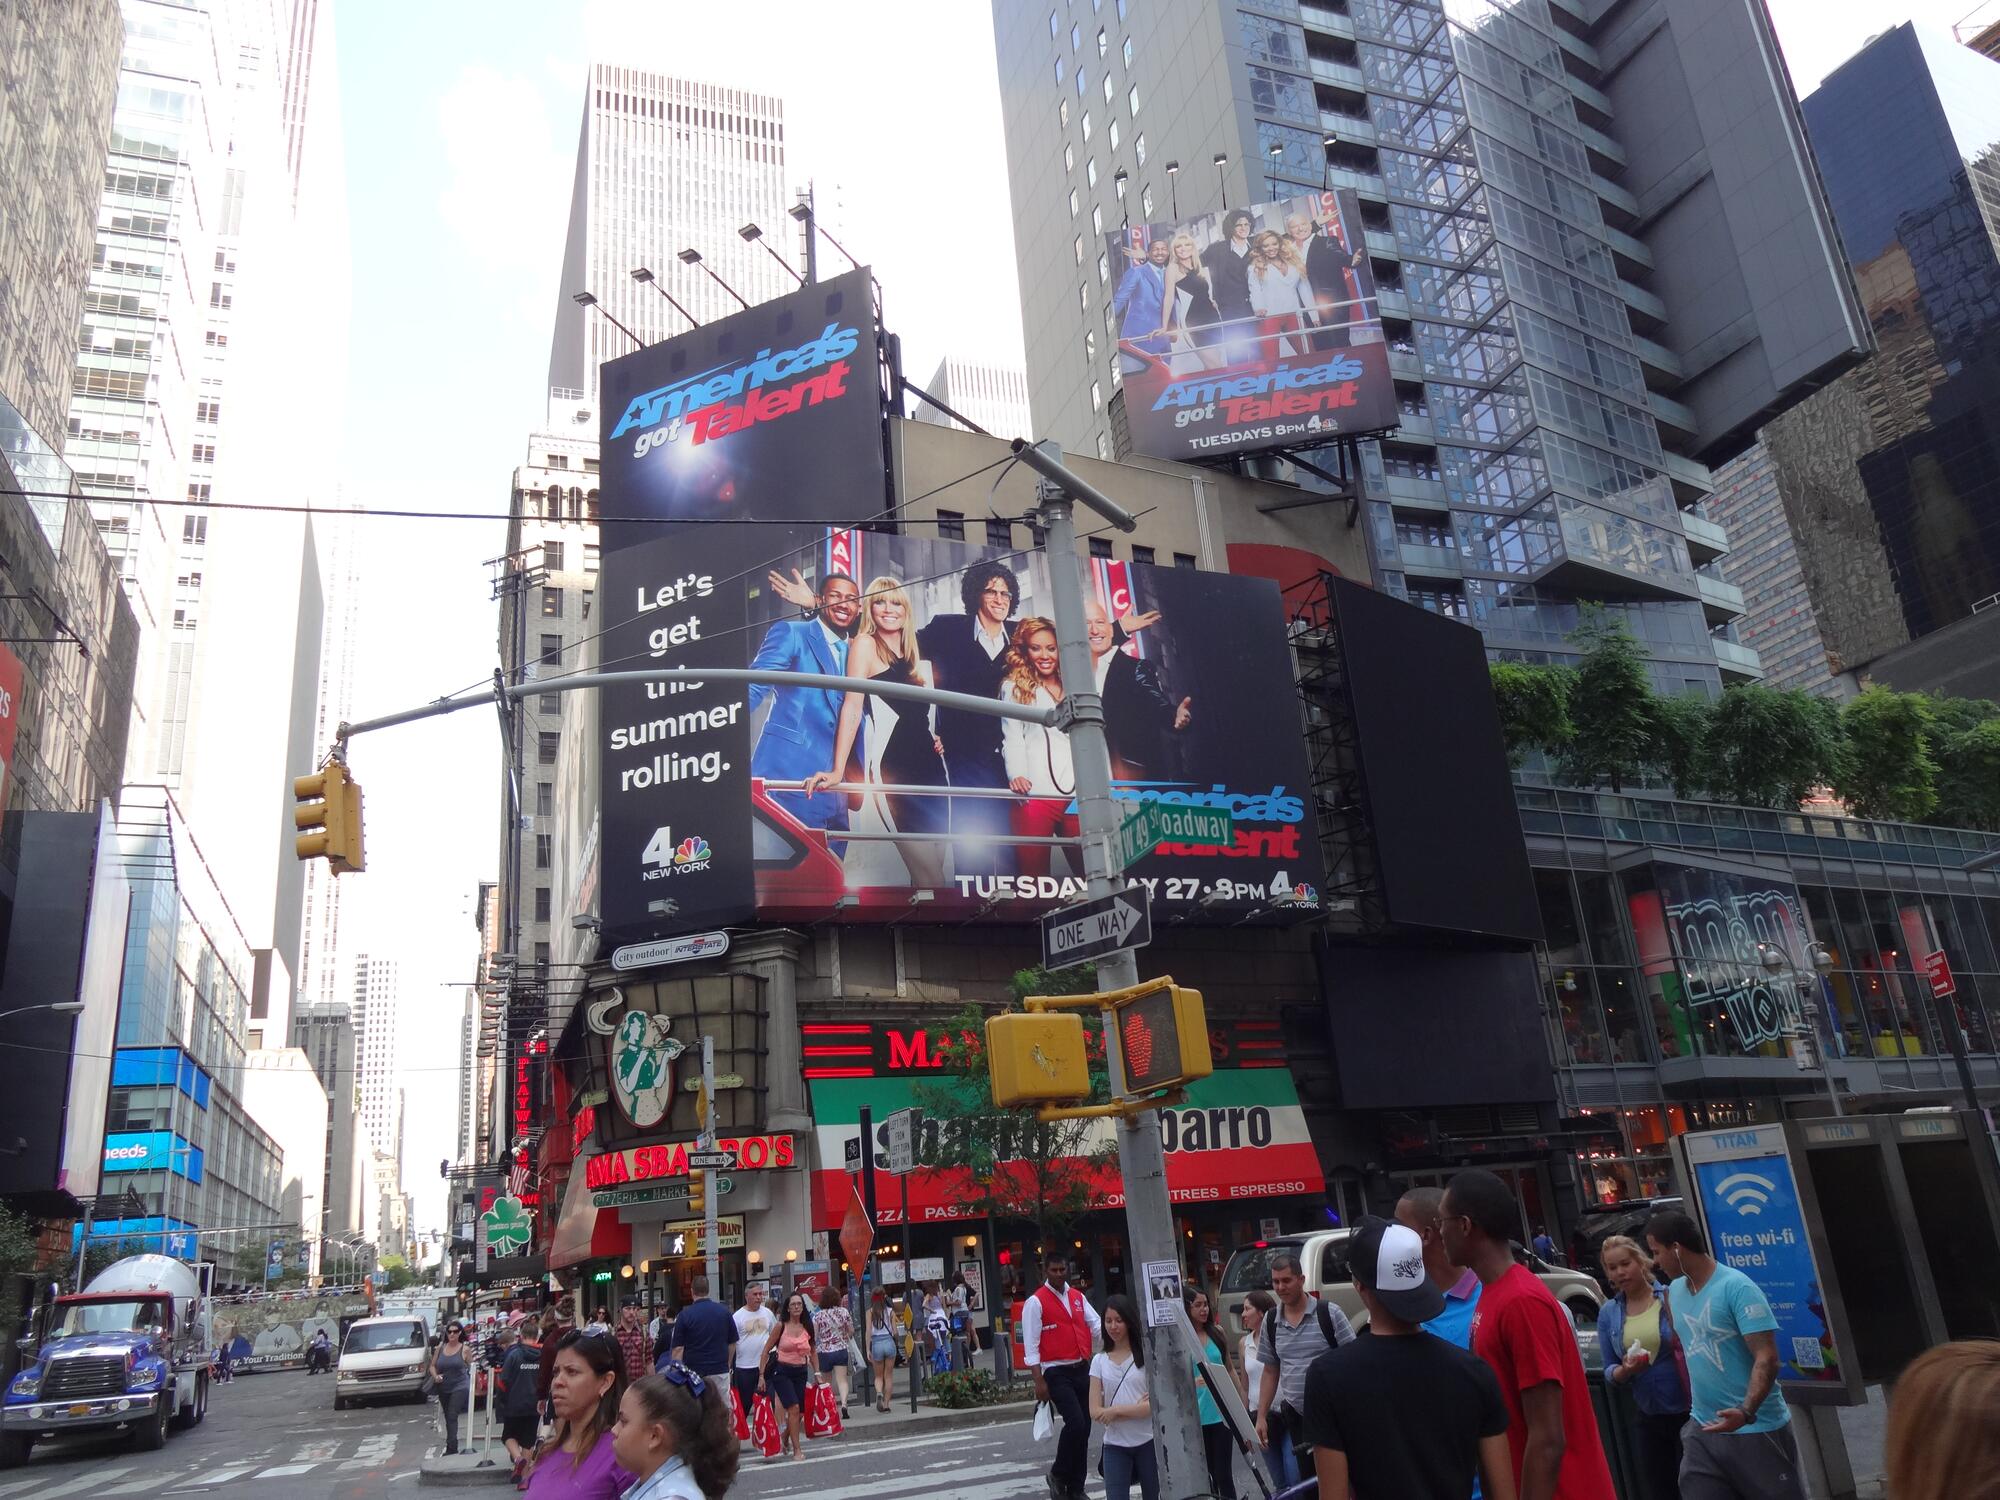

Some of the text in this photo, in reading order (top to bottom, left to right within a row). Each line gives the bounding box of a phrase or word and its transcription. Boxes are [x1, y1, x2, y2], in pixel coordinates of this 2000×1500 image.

[609, 322, 860, 441] America's
[1151, 354, 1363, 412] America's
[633, 360, 850, 459] got Talent
[1175, 381, 1360, 428] got Talent
[1307, 414, 1322, 430] 4
[1189, 424, 1306, 450] TUESDAYS 8PM
[637, 573, 714, 613] Let's
[649, 615, 702, 658] get
[610, 702, 743, 750] summer
[621, 751, 731, 792] rolling.
[1122, 824, 1134, 860] W
[1136, 815, 1149, 850] 49
[1161, 808, 1229, 846] oadway
[642, 825, 675, 868] 4
[643, 859, 711, 881] NEW YORK
[1294, 901, 1320, 910] YORK
[1057, 908, 1130, 949] ONE WAY
[635, 947, 670, 960] outdoor
[1822, 1124, 1855, 1139] TITAN
[1914, 1120, 1943, 1135] TITAN
[1711, 1132, 1758, 1149] TITAN
[694, 1156, 731, 1165] ONE WAY
[1168, 1186, 1220, 1201] TREES
[1230, 1181, 1306, 1197] ESPRESSO
[1721, 1227, 1795, 1248] free wi-fi
[1725, 1250, 1767, 1268] here!
[596, 1271, 612, 1281] ATM
[244, 1354, 264, 1365] Your
[264, 1351, 306, 1363] Tradition.
